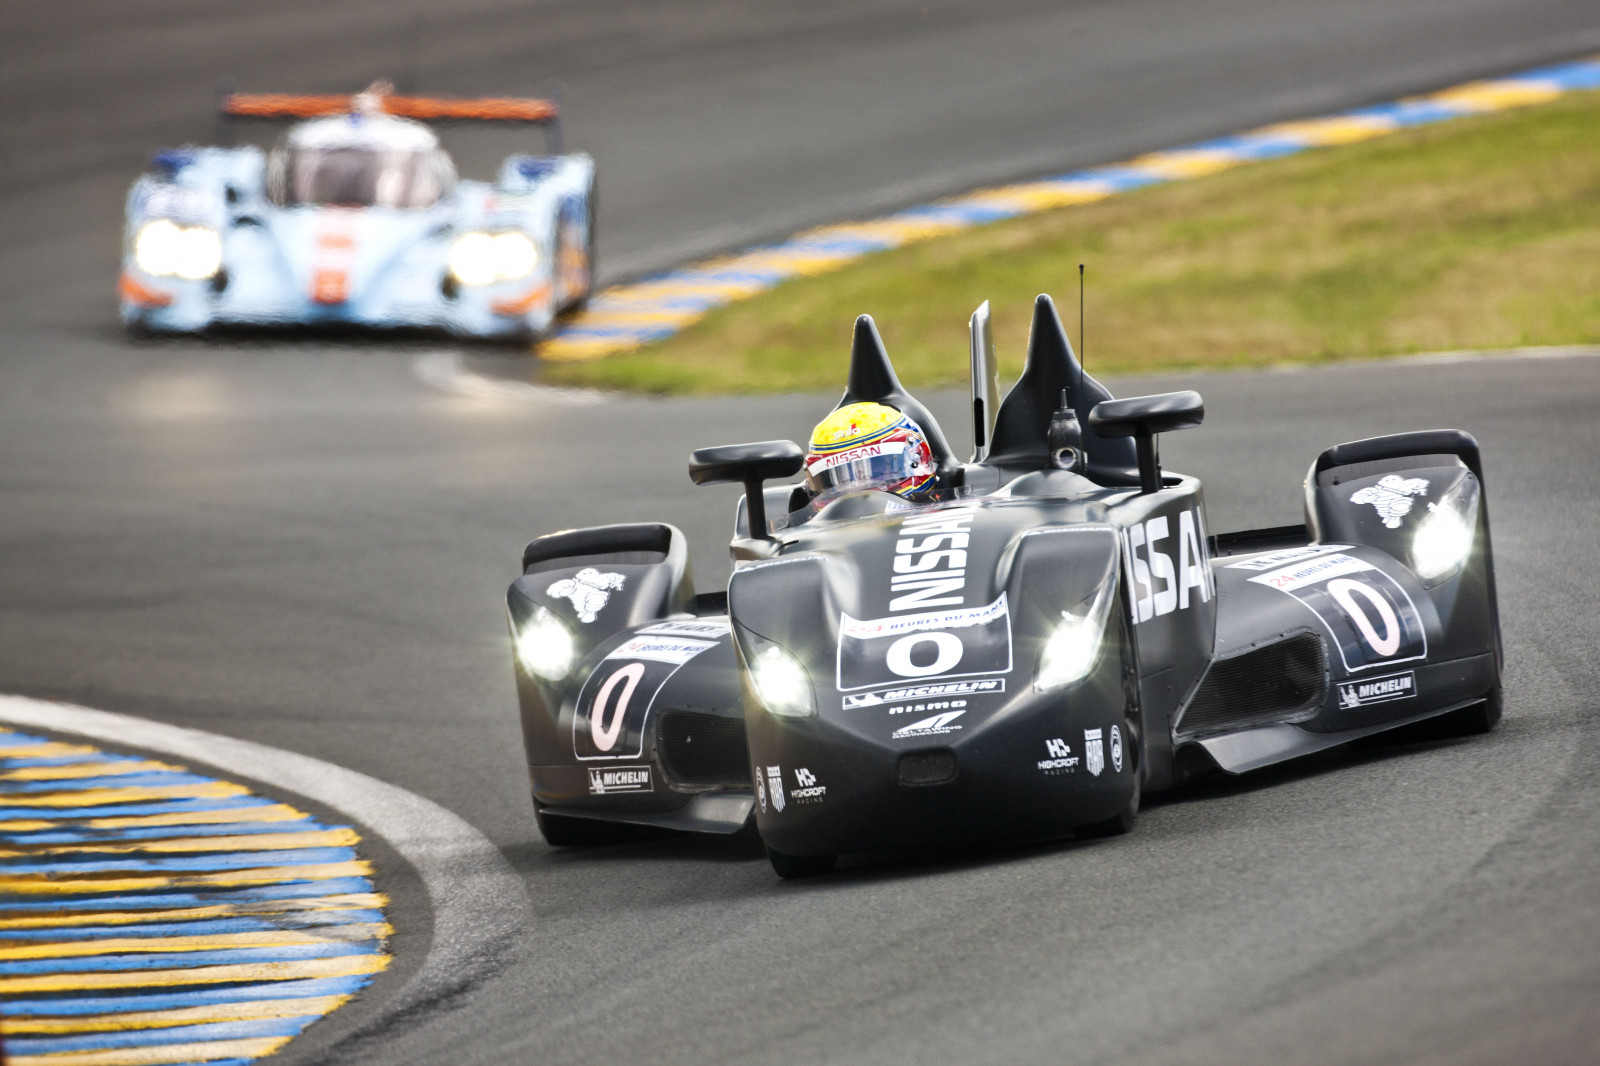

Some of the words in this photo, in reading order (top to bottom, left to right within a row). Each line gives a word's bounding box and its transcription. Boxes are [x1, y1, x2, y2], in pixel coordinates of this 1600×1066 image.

[826, 445, 881, 468] NISSAN
[1270, 575, 1296, 587] 24
[890, 618, 939, 630] HEURES
[945, 614, 963, 622] DU
[1327, 578, 1401, 657] 0
[886, 632, 964, 677] 0
[884, 681, 998, 700] MICHELIN
[1359, 676, 1412, 697] MICHELIN
[591, 662, 645, 751] 0
[888, 700, 967, 715] nismo
[1038, 757, 1079, 770] HIGHCROFT
[603, 770, 649, 785] MICHELIN
